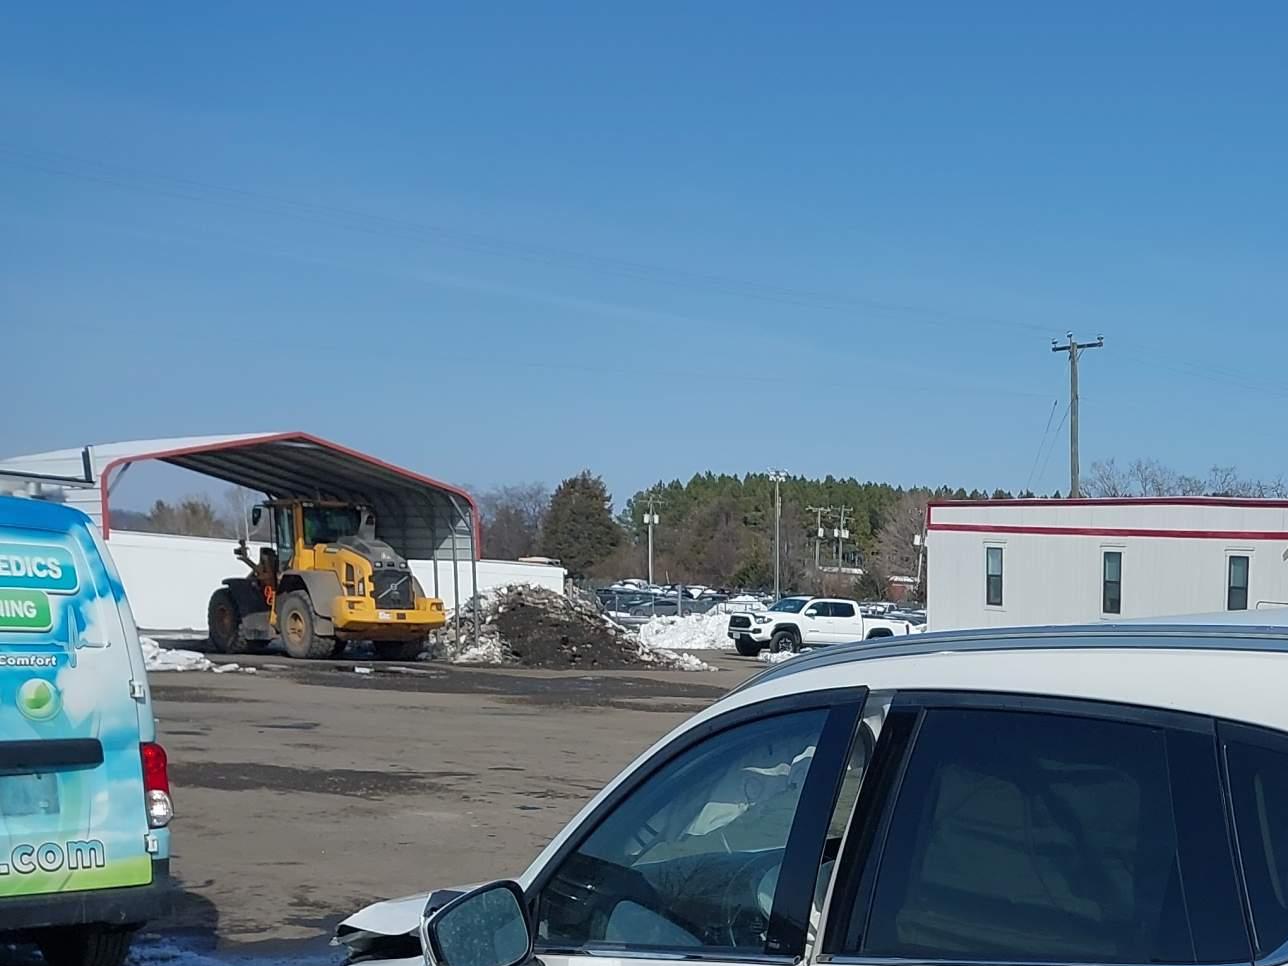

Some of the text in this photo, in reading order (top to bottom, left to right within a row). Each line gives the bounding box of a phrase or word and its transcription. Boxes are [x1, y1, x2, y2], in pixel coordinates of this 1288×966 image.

[0, 554, 63, 579] EDICS
[0, 655, 57, 667] Comfort
[0, 839, 105, 876] .com
